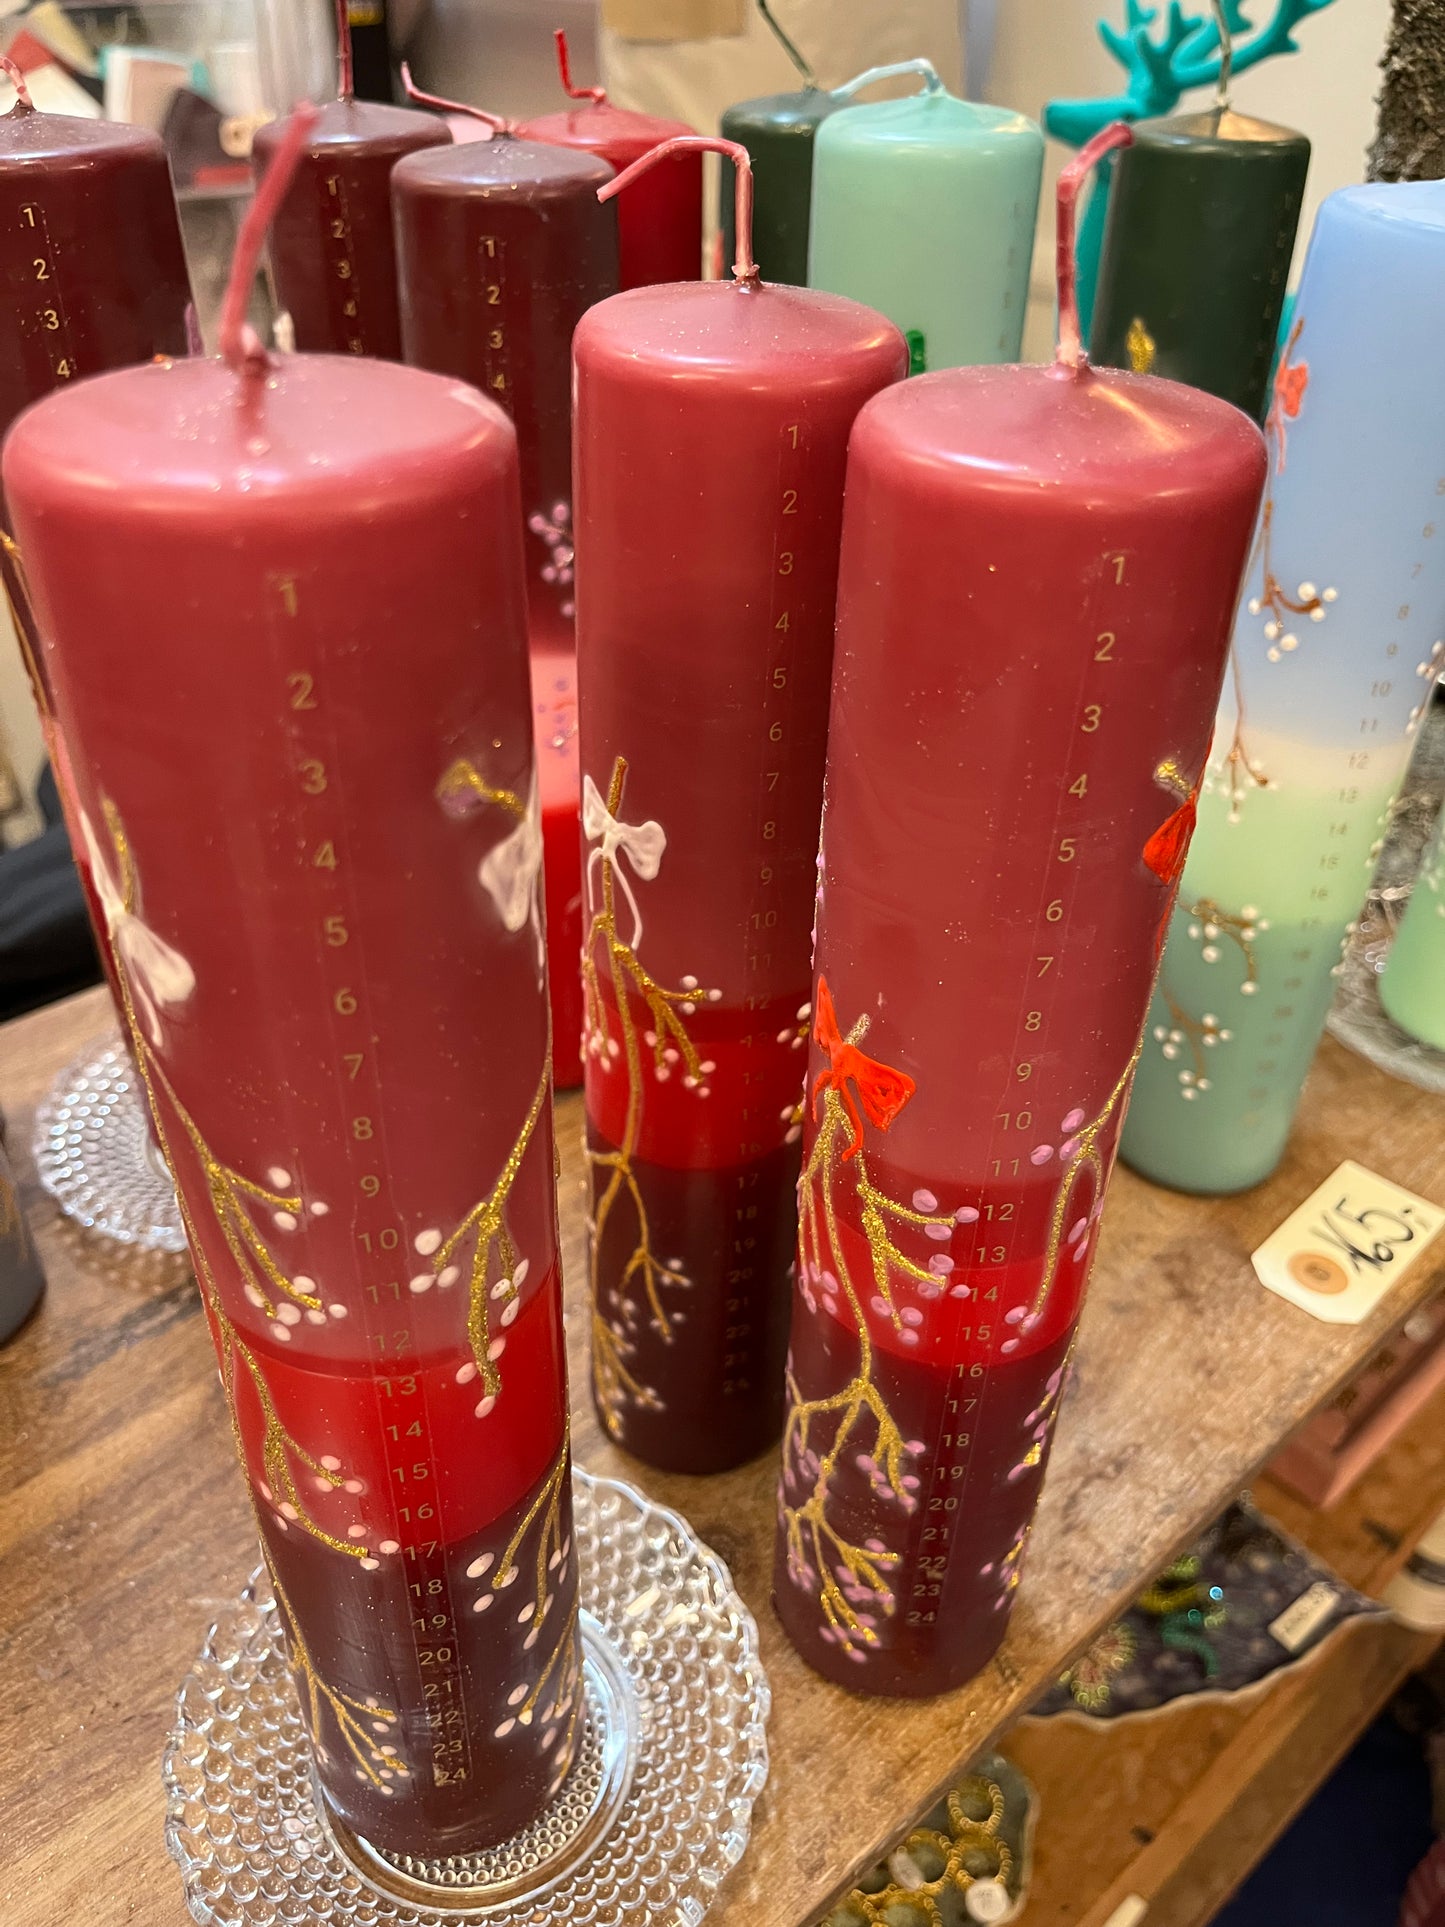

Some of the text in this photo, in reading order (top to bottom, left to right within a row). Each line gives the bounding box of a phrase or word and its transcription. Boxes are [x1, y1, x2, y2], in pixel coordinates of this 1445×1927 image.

[327, 177, 337, 196] 1
[23, 207, 35, 227] 1
[331, 218, 344, 238] 2
[485, 239, 495, 258] 1
[33, 258, 50, 280] 2
[338, 259, 351, 279] 3
[487, 285, 500, 305] 2
[344, 300, 357, 317] 4
[44, 310, 59, 330] 3
[490, 330, 503, 349] 3
[56, 359, 71, 378] 4
[492, 373, 506, 390] 4
[788, 425, 798, 449] 1
[783, 490, 797, 514] 2
[779, 552, 793, 575] 3
[1112, 556, 1125, 585] 1
[279, 581, 297, 617] 1
[775, 611, 790, 632] 4
[1094, 632, 1115, 661] 2
[773, 668, 786, 689] 5
[287, 672, 317, 709] 2
[1371, 680, 1392, 697] 10
[1081, 705, 1101, 732] 3
[769, 722, 782, 741] 6
[1349, 753, 1368, 769] 12
[300, 758, 327, 794] 3
[767, 772, 779, 792] 7
[1068, 773, 1087, 799] 4
[763, 821, 775, 839] 8
[314, 840, 336, 870] 4
[1058, 838, 1076, 862] 5
[761, 867, 772, 885] 9
[1046, 899, 1063, 921] 6
[752, 911, 777, 929] 10
[325, 916, 348, 947] 5
[750, 954, 771, 971] 11
[1037, 957, 1054, 977] 7
[334, 988, 357, 1015] 6
[1025, 1011, 1042, 1031] 8
[344, 1053, 364, 1080] 7
[1016, 1063, 1032, 1081] 9
[353, 1116, 373, 1140] 8
[996, 1111, 1032, 1130] 10
[992, 1159, 1019, 1176] 11
[360, 1175, 380, 1197] 9
[984, 1203, 1014, 1221] 12
[358, 1228, 398, 1252] 10
[976, 1246, 1006, 1263] 13
[367, 1282, 400, 1304] 11
[969, 1286, 998, 1302] 14
[373, 1330, 410, 1351] 12
[962, 1325, 991, 1341] 15
[955, 1363, 983, 1378] 16
[380, 1376, 417, 1397] 13
[949, 1399, 977, 1413] 17
[386, 1420, 423, 1441] 14
[943, 1433, 970, 1447] 18
[393, 1463, 428, 1483] 15
[938, 1466, 963, 1479] 19
[400, 1503, 433, 1522] 16
[929, 1497, 958, 1510] 20
[923, 1528, 949, 1540] 21
[405, 1541, 437, 1561] 17
[918, 1556, 946, 1569] 22
[410, 1579, 443, 1597] 18
[914, 1584, 940, 1596] 23
[414, 1614, 447, 1632] 19
[908, 1611, 935, 1623] 24
[419, 1648, 451, 1665] 20
[424, 1680, 452, 1697] 21
[430, 1710, 459, 1727] 22
[433, 1740, 462, 1756] 23
[436, 1767, 466, 1784] 24
